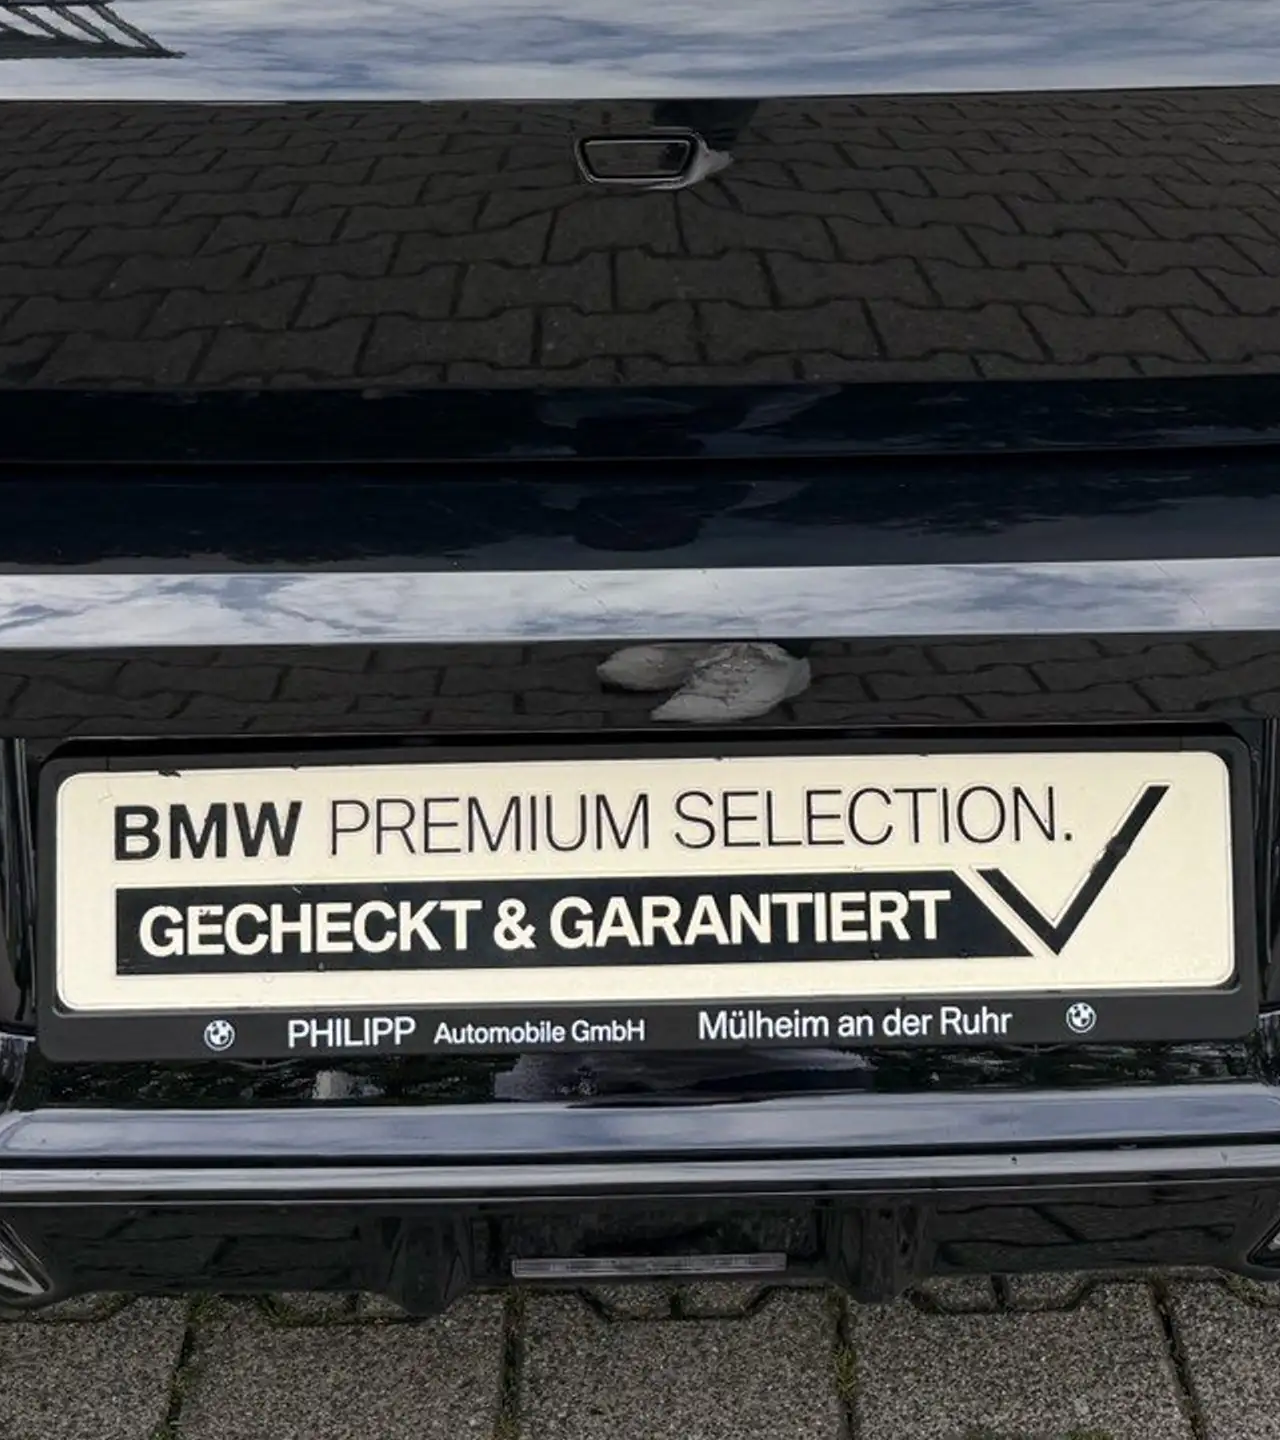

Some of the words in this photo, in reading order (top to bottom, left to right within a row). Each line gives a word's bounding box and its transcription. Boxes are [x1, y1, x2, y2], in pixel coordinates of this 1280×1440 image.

[115, 800, 303, 861] BMW
[330, 793, 649, 855] PREMIUM
[673, 785, 1075, 850] SELECTION.
[138, 900, 482, 958] GECHECKT
[492, 897, 537, 950] &
[549, 890, 951, 949] GARANTIERT
[287, 1016, 417, 1048] PHILIPP
[433, 1021, 566, 1046] Automobile
[570, 1019, 646, 1044] GmbH
[697, 1010, 829, 1041] Mülheim
[837, 1016, 874, 1039] an
[881, 1007, 934, 1038] der
[939, 1004, 1014, 1036] Ruhr
